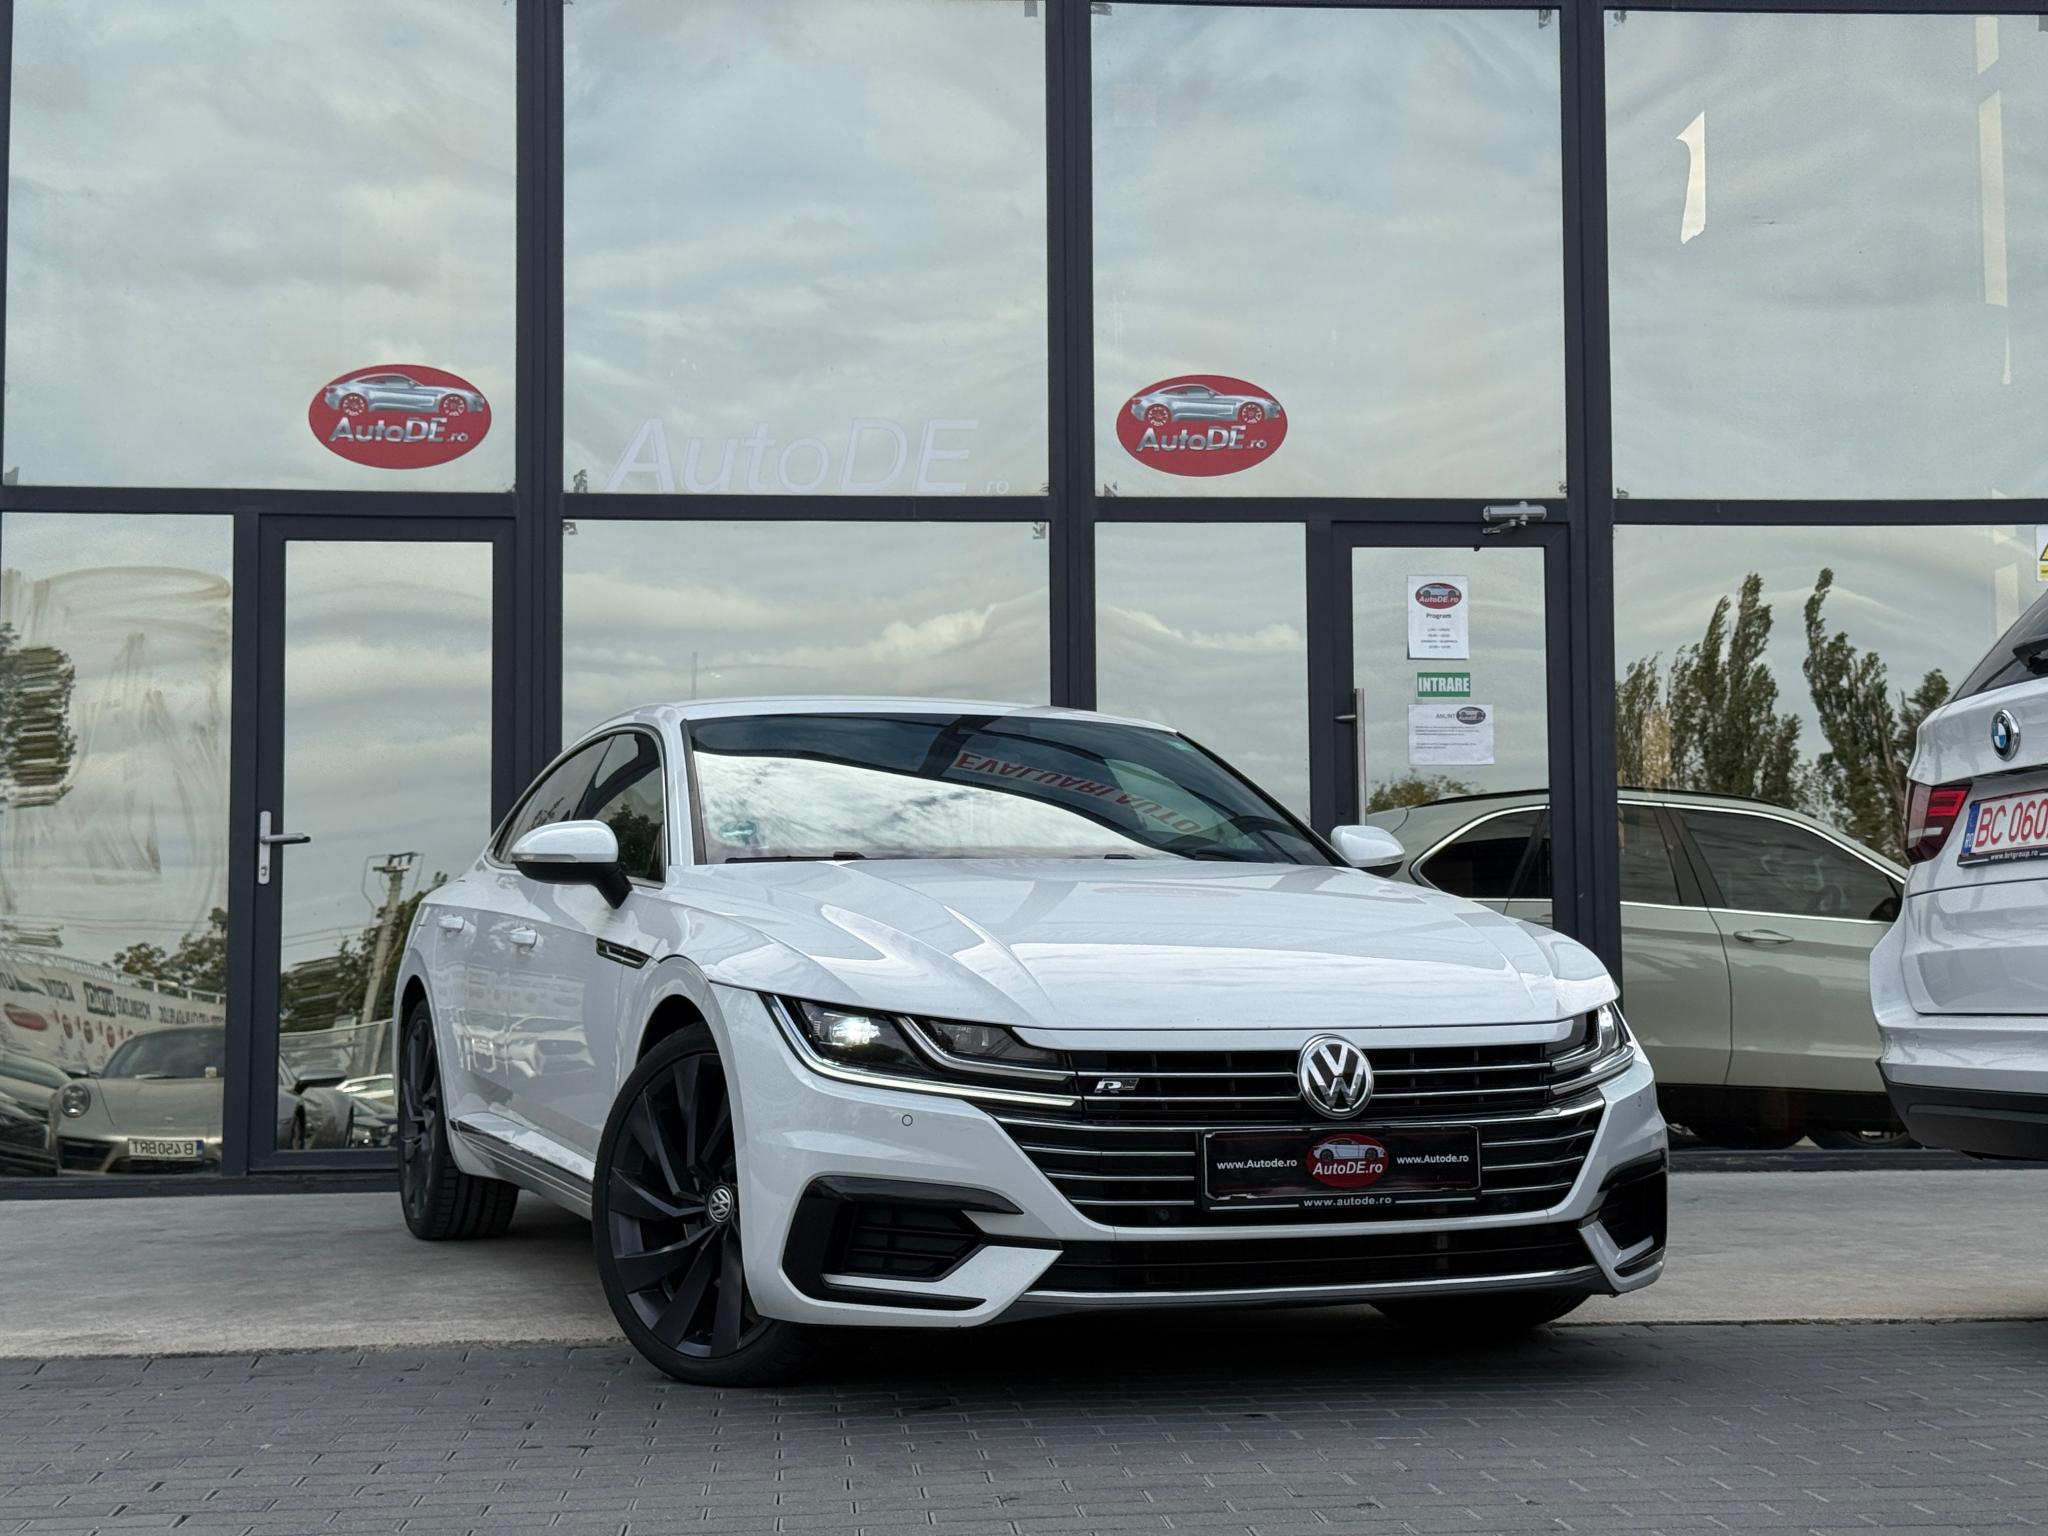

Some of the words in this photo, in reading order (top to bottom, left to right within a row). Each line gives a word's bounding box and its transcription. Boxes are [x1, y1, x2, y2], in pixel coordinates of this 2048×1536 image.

[1418, 677, 1470, 692] INTRARE
[1975, 804, 2007, 848] BC
[2009, 798, 2048, 843] 060
[1217, 1157, 1298, 1170] www.Autode.ro
[1396, 1154, 1470, 1165] www.Autode.ro
[1312, 1161, 1384, 1176] AutoDE.ro
[1303, 1196, 1392, 1207] www.autode.ro
